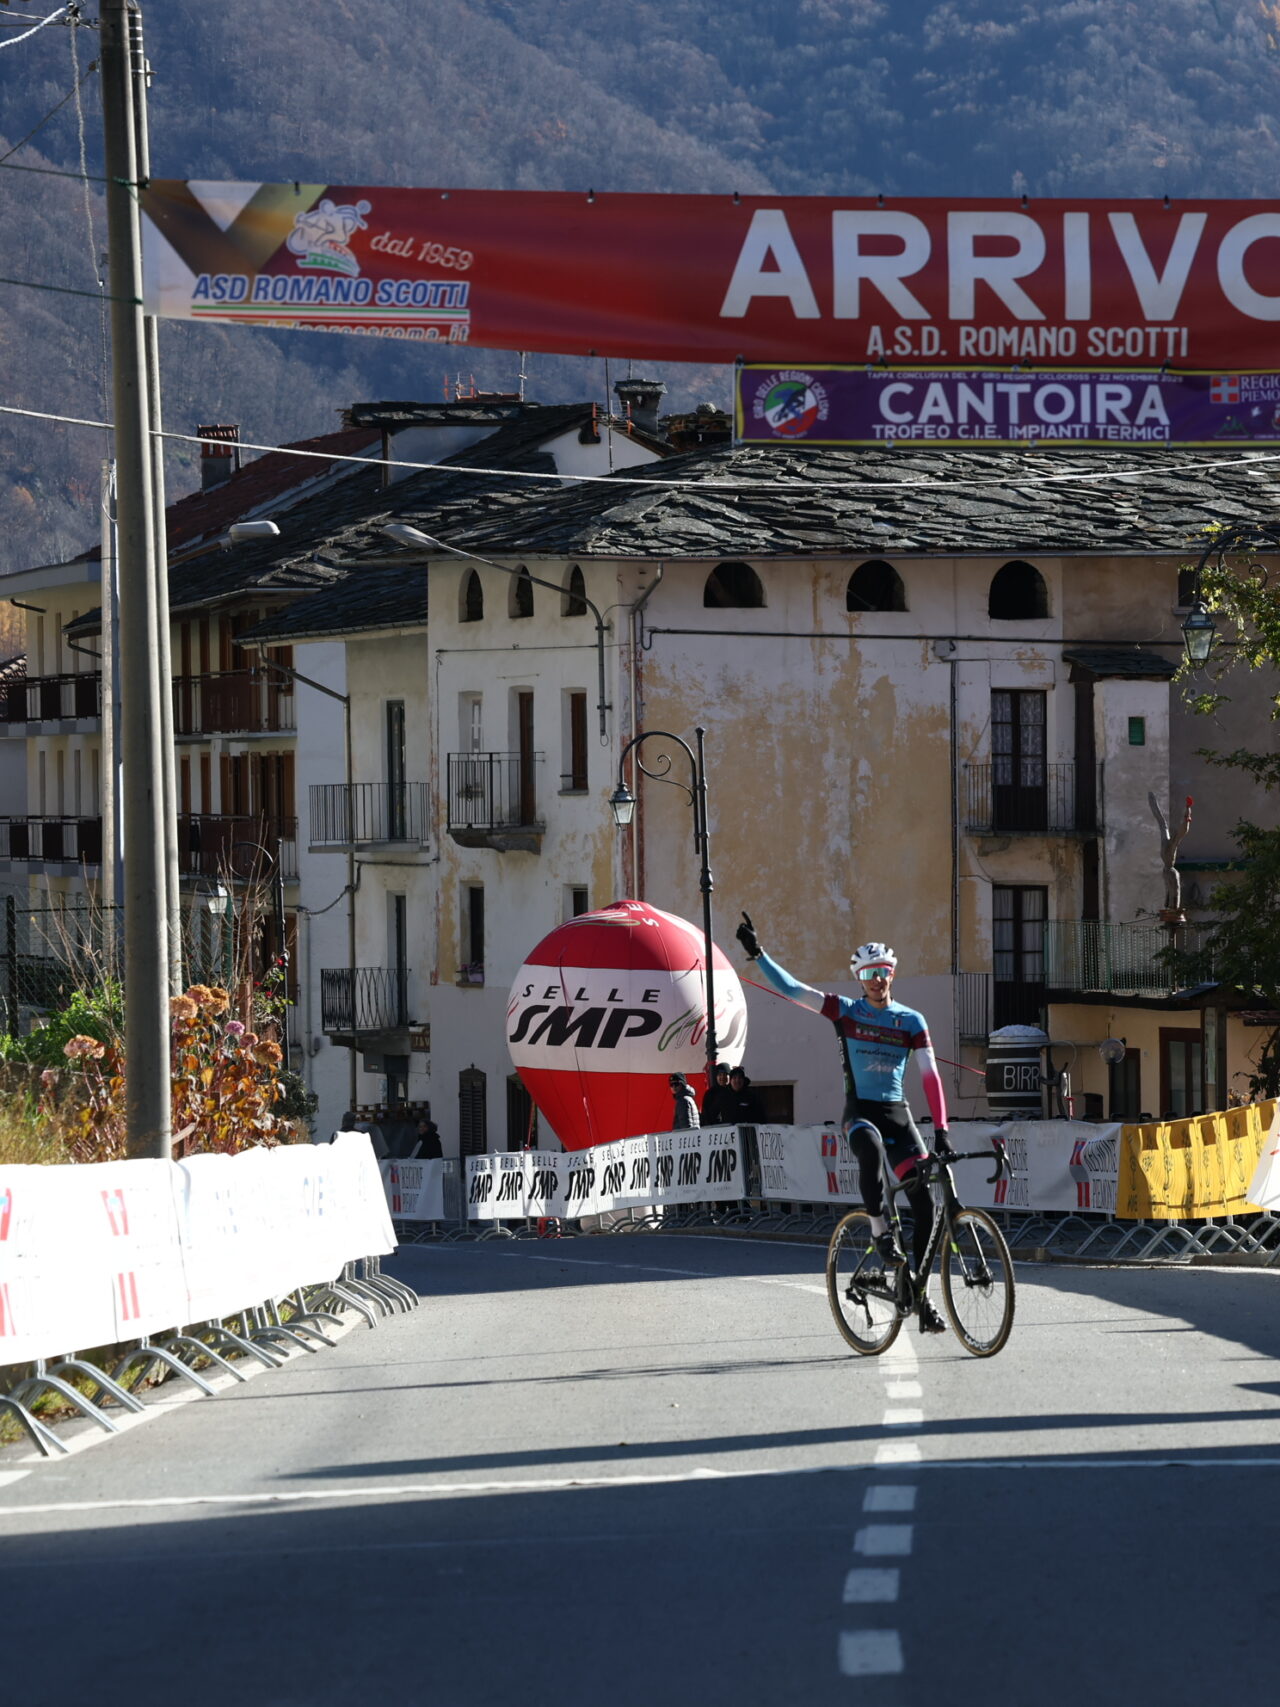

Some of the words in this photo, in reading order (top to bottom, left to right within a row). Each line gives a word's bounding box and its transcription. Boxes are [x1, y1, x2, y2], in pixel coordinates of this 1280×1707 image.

[371, 232, 414, 257] dal
[417, 241, 473, 271] 1959
[191, 274, 248, 301] ASD
[253, 276, 371, 305] ROMANO
[376, 279, 470, 307] SCOTTI
[866, 325, 948, 357] A.S.D.
[959, 325, 1076, 358] ROMANO
[1087, 326, 1188, 358] SCOTTI
[879, 382, 1171, 426] CANTOIRA
[872, 424, 950, 439] TROFEO
[957, 424, 1002, 439] C.I.E.
[1009, 423, 1088, 439] IMPIANTI
[1096, 424, 1170, 440] TERMICI
[866, 945, 876, 954] 2
[522, 984, 661, 1003] SELLE
[509, 1005, 662, 1049] SMP
[630, 1157, 650, 1190] SMP
[678, 1152, 702, 1186] SMP
[706, 1149, 737, 1183] SMP
[469, 1174, 493, 1203] SMP
[496, 1171, 523, 1201] SMP
[528, 1170, 558, 1200] SMP
[564, 1168, 595, 1201] SMP
